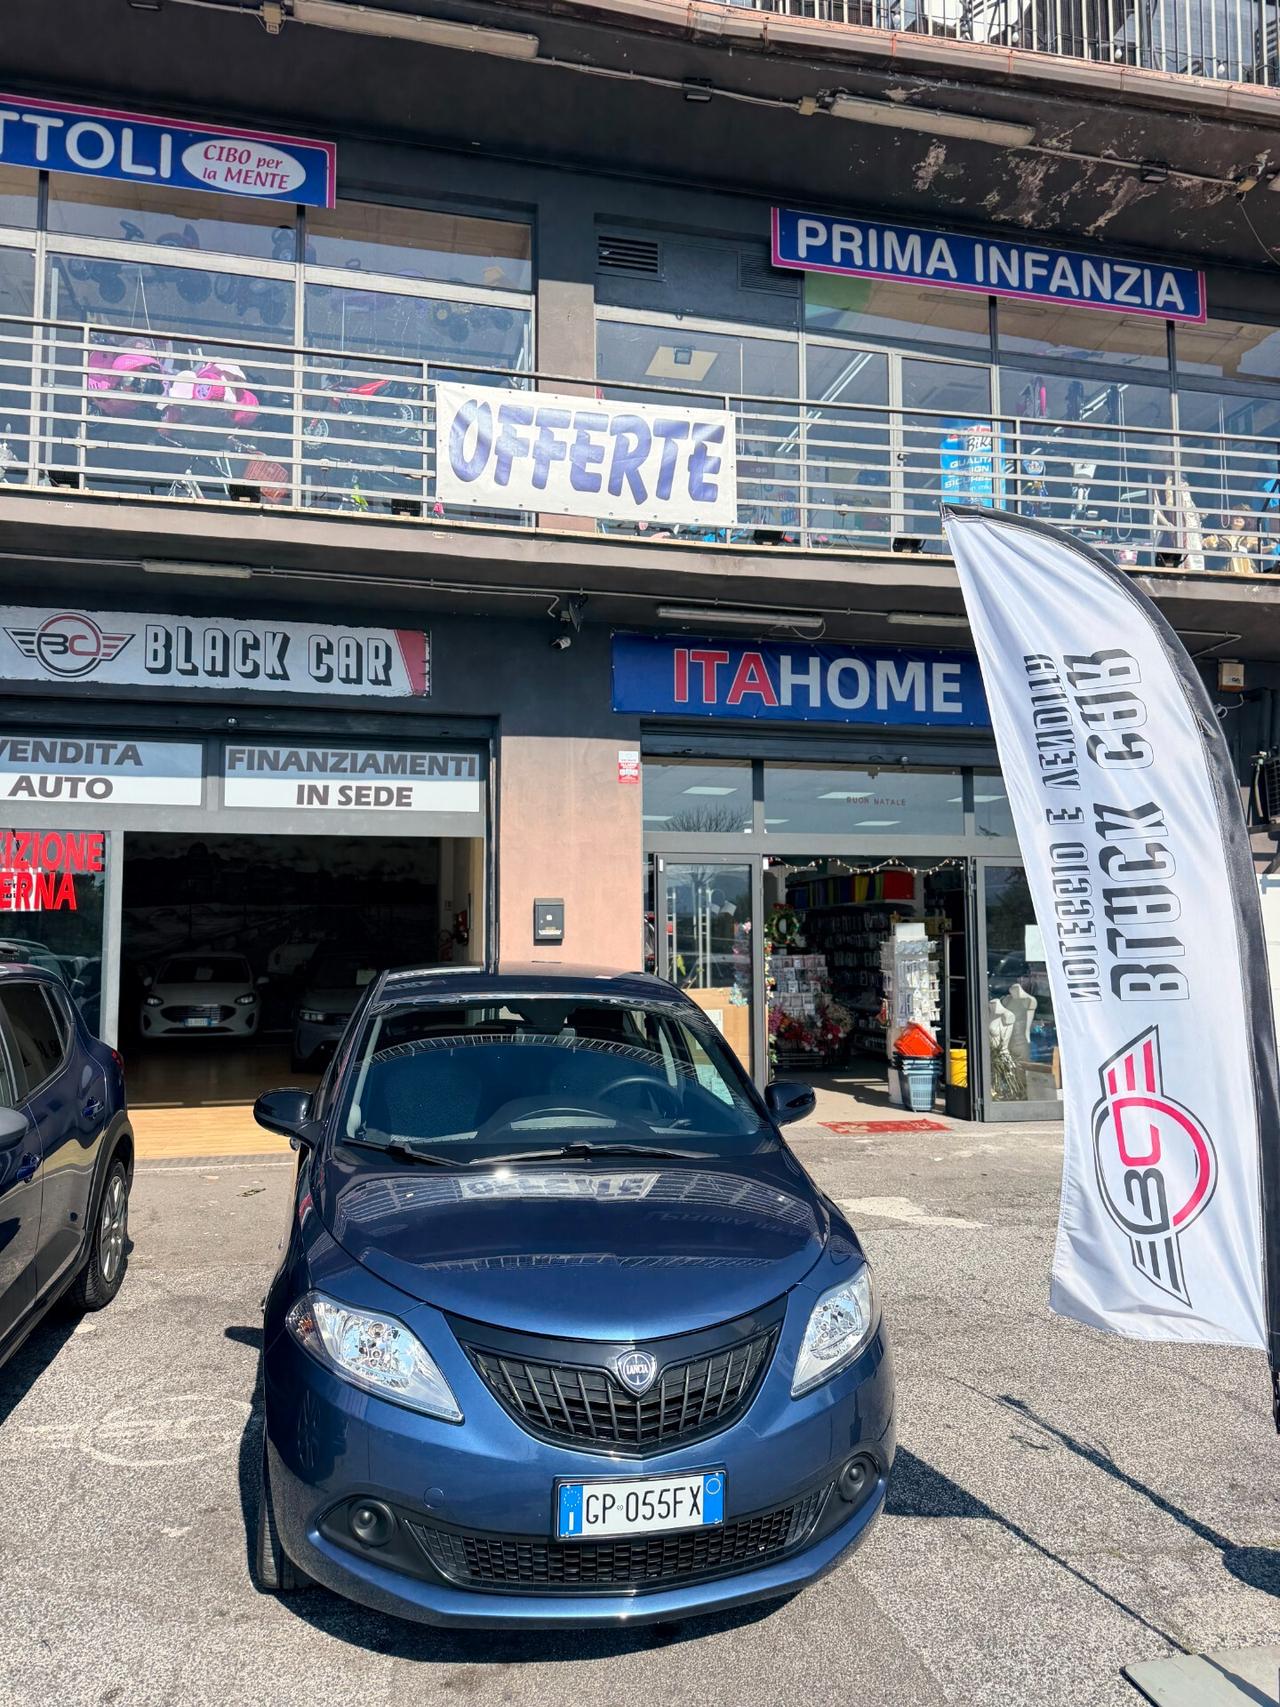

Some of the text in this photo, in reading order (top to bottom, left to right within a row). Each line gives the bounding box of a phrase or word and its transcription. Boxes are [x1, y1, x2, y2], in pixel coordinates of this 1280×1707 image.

[203, 144, 283, 169] CIBO per
[202, 166, 290, 190] la MENTE
[797, 218, 1186, 311] PRIMA INFANZIA
[449, 399, 725, 506] OFFERTE
[144, 624, 393, 686] BLACK CAR
[674, 648, 963, 713] ITAHOME
[227, 748, 476, 777] FINANZIAMENTI
[8, 775, 113, 799] AUTO
[296, 784, 413, 807] IN SEDE
[873, 798, 906, 806] NATALE
[0, 831, 104, 872] IZIONE
[626, 1364, 648, 1375] LANCIA
